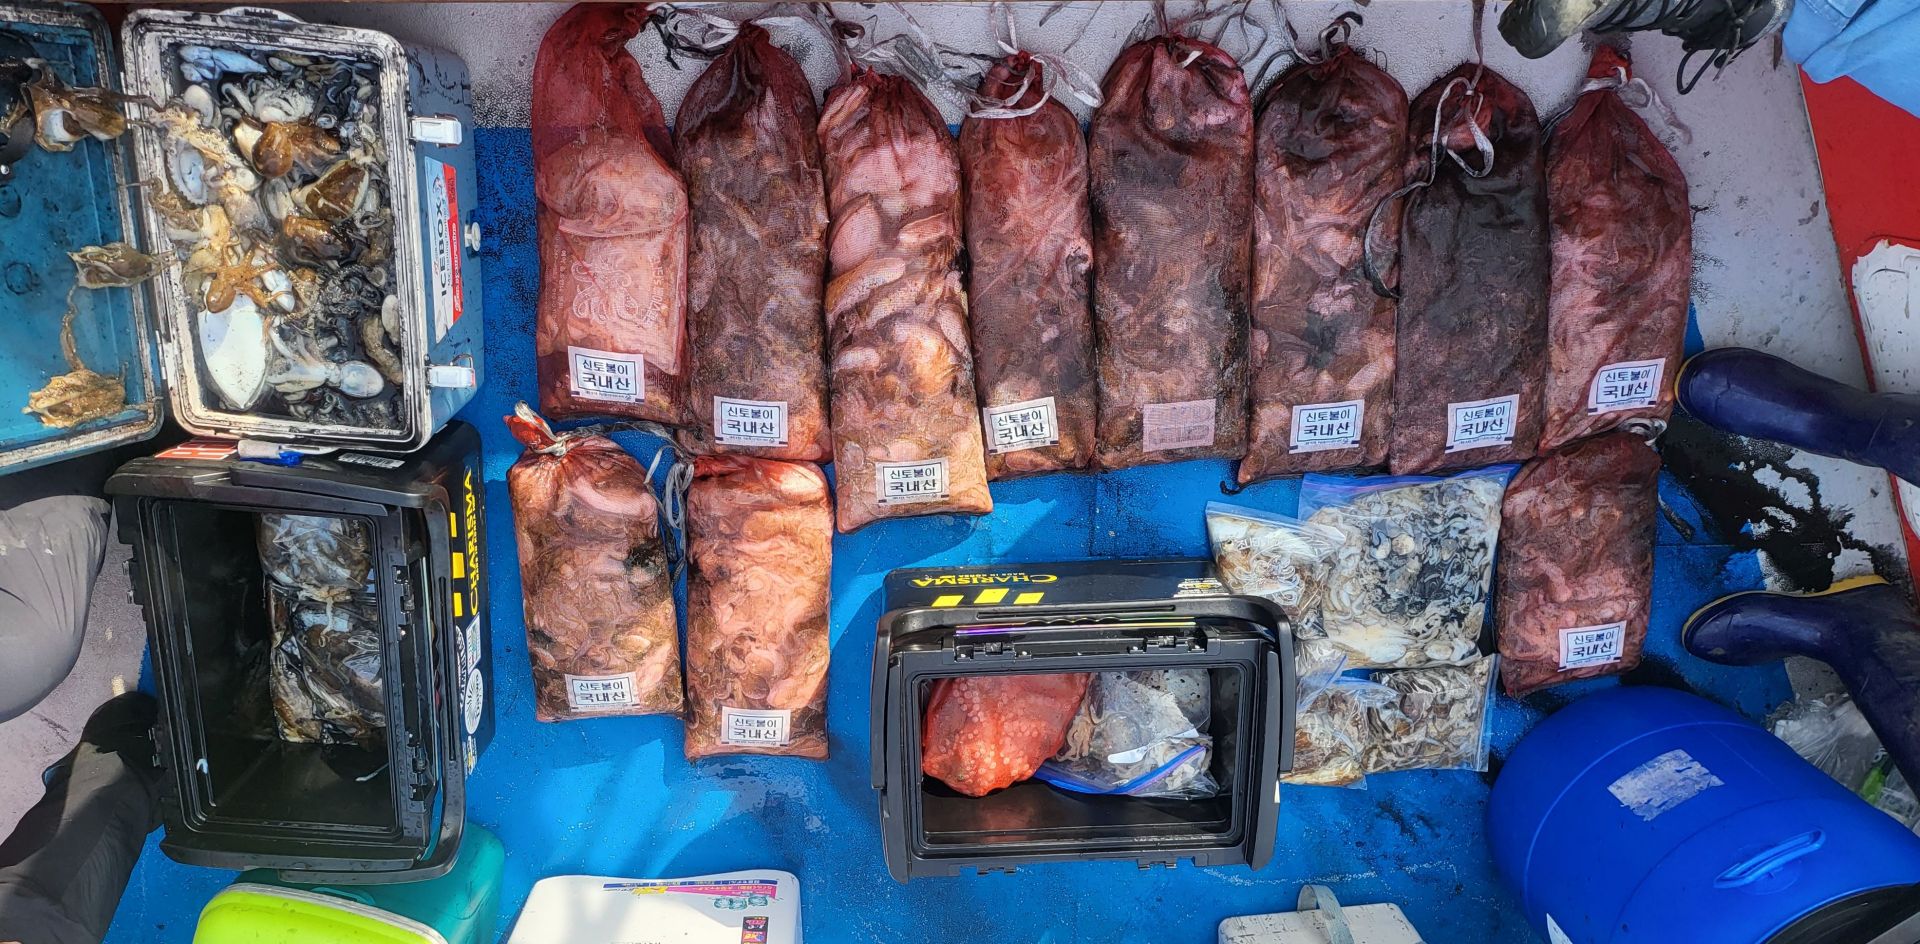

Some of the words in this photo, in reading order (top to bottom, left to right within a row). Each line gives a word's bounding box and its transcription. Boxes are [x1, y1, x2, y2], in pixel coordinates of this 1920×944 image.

[436, 201, 447, 297] ICEBOX
[582, 372, 630, 391] 국내산
[1603, 380, 1648, 399] 국내산
[726, 418, 774, 434] 국내산
[998, 421, 1045, 442] 국내산
[1303, 420, 1350, 438] 국내산
[1460, 418, 1504, 436] 국내산
[889, 478, 937, 493] 국내산
[464, 468, 479, 616] CHARISMA
[911, 574, 1058, 587] CHARISMA
[1572, 641, 1614, 657] 국내산
[579, 690, 626, 703] 국내산
[733, 727, 777, 740] 국내산
